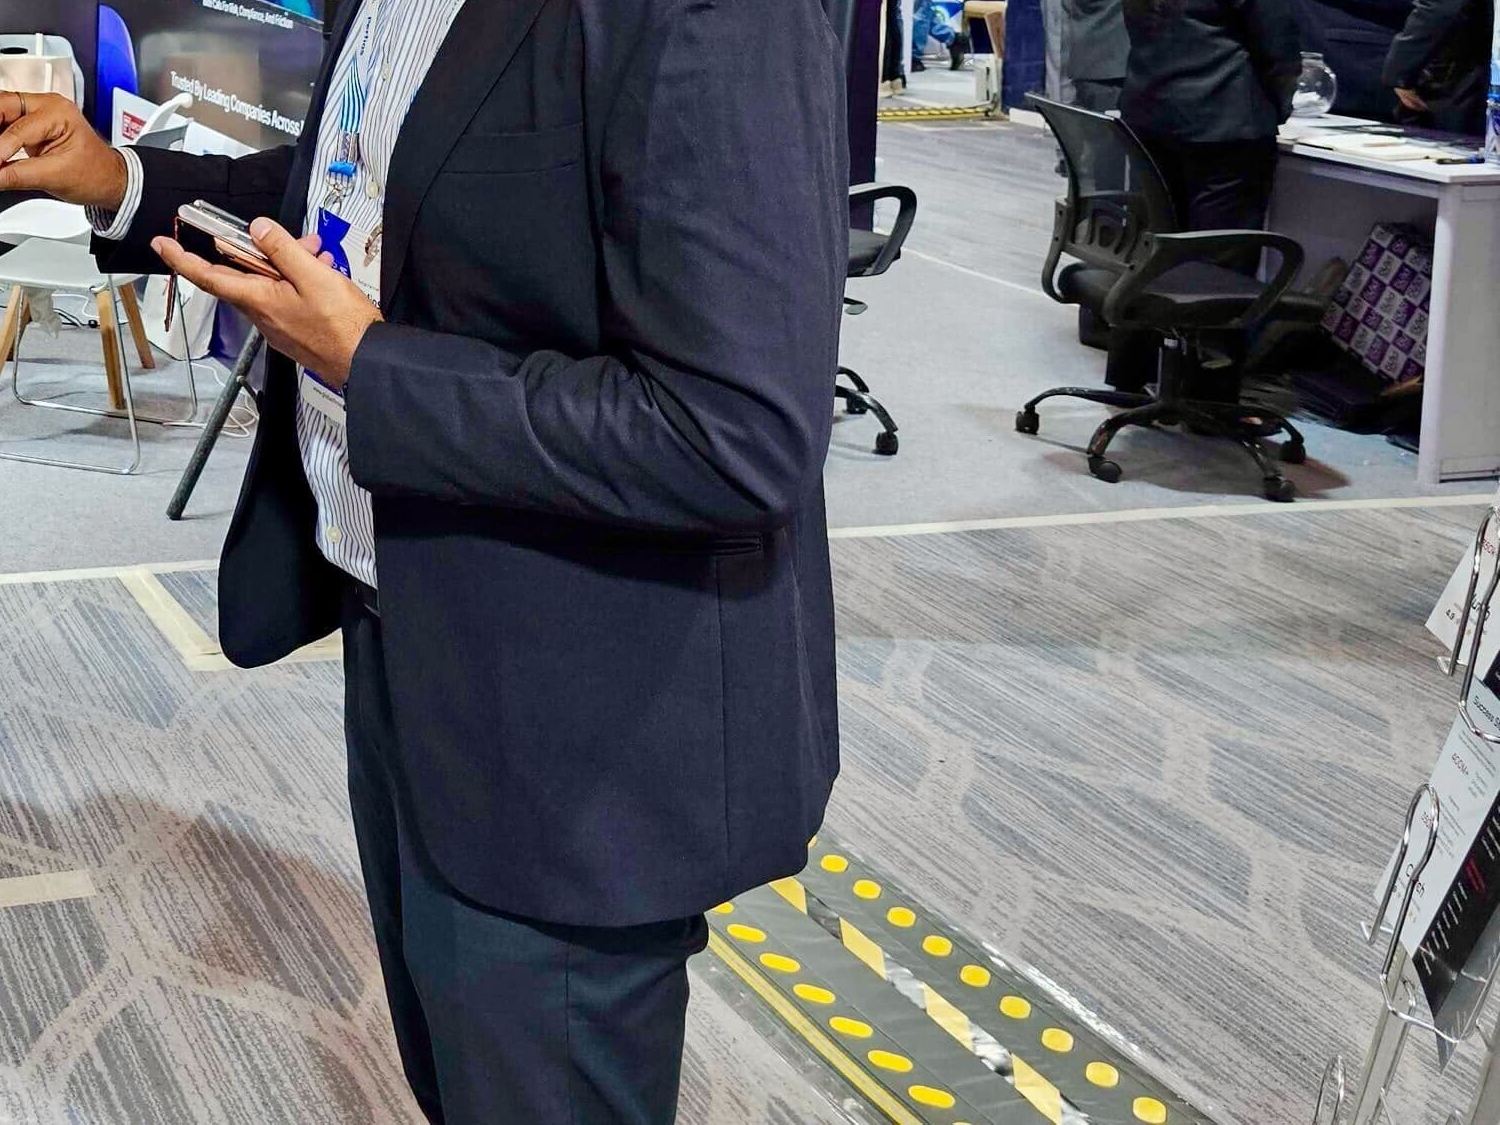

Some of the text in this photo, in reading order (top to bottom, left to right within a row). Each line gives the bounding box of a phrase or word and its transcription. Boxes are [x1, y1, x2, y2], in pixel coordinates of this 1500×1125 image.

[171, 71, 301, 137] Trusted By Leading Companies Across
